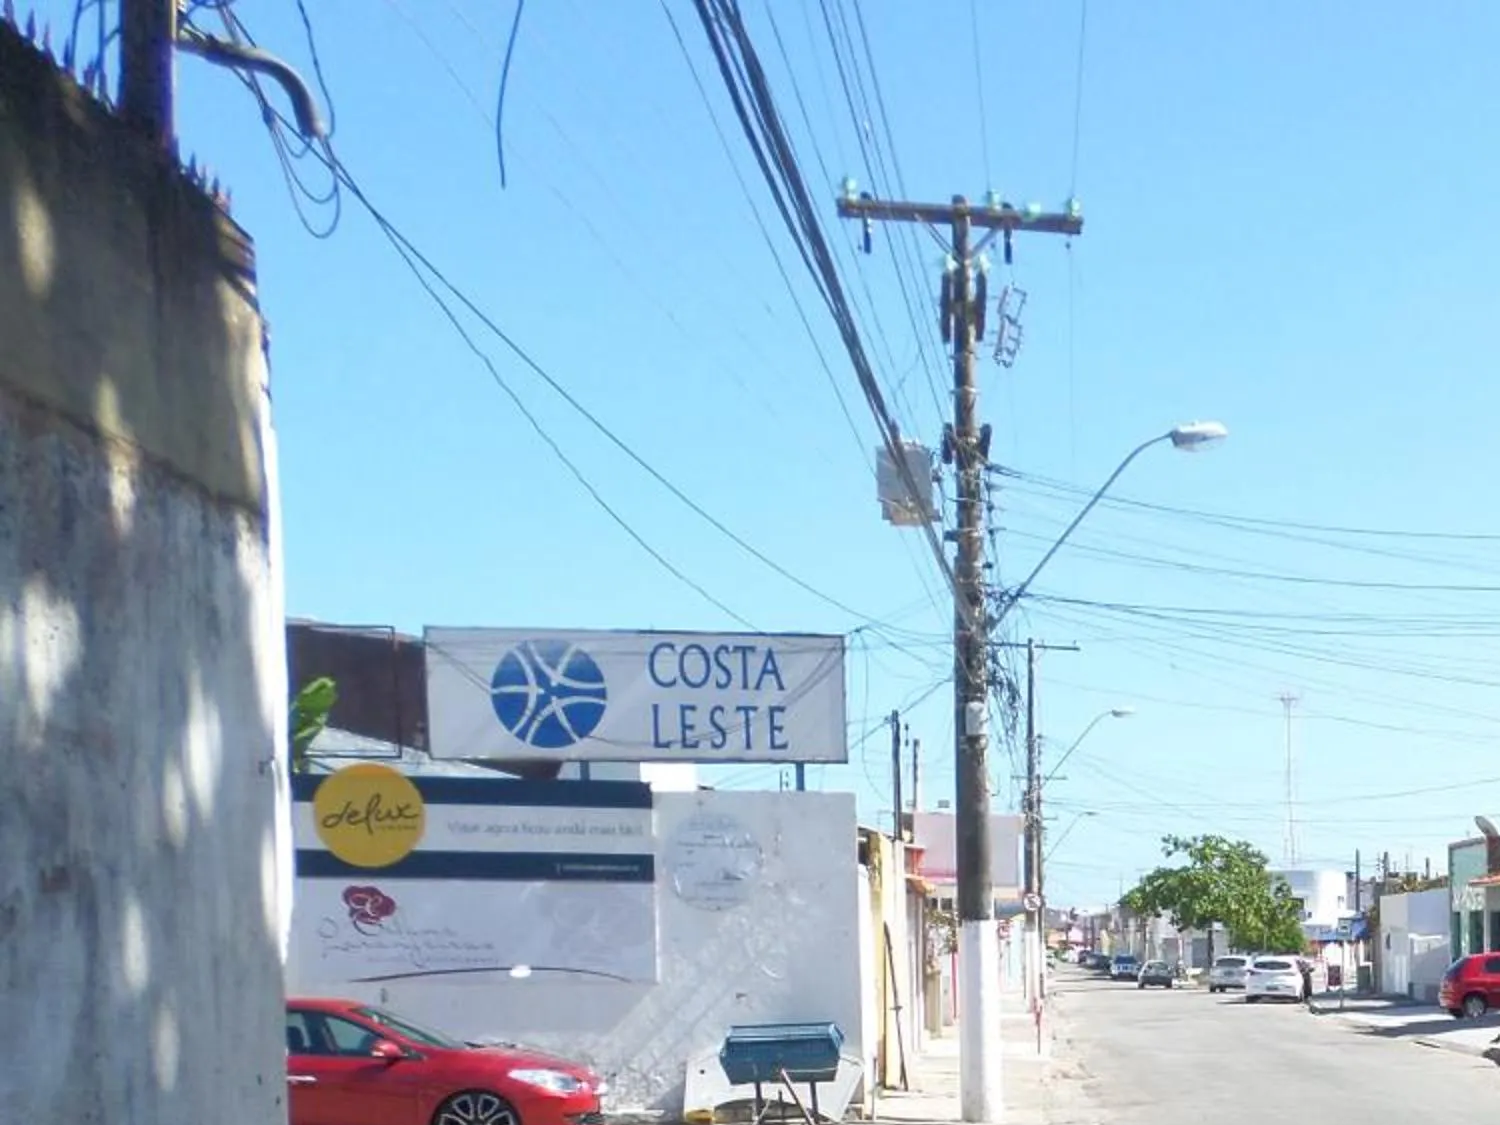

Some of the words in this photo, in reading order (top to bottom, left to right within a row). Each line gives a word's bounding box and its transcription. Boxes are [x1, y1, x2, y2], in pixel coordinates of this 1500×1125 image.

[648, 641, 786, 691] COSTA
[651, 703, 790, 751] LESTE
[321, 791, 419, 836] delux
